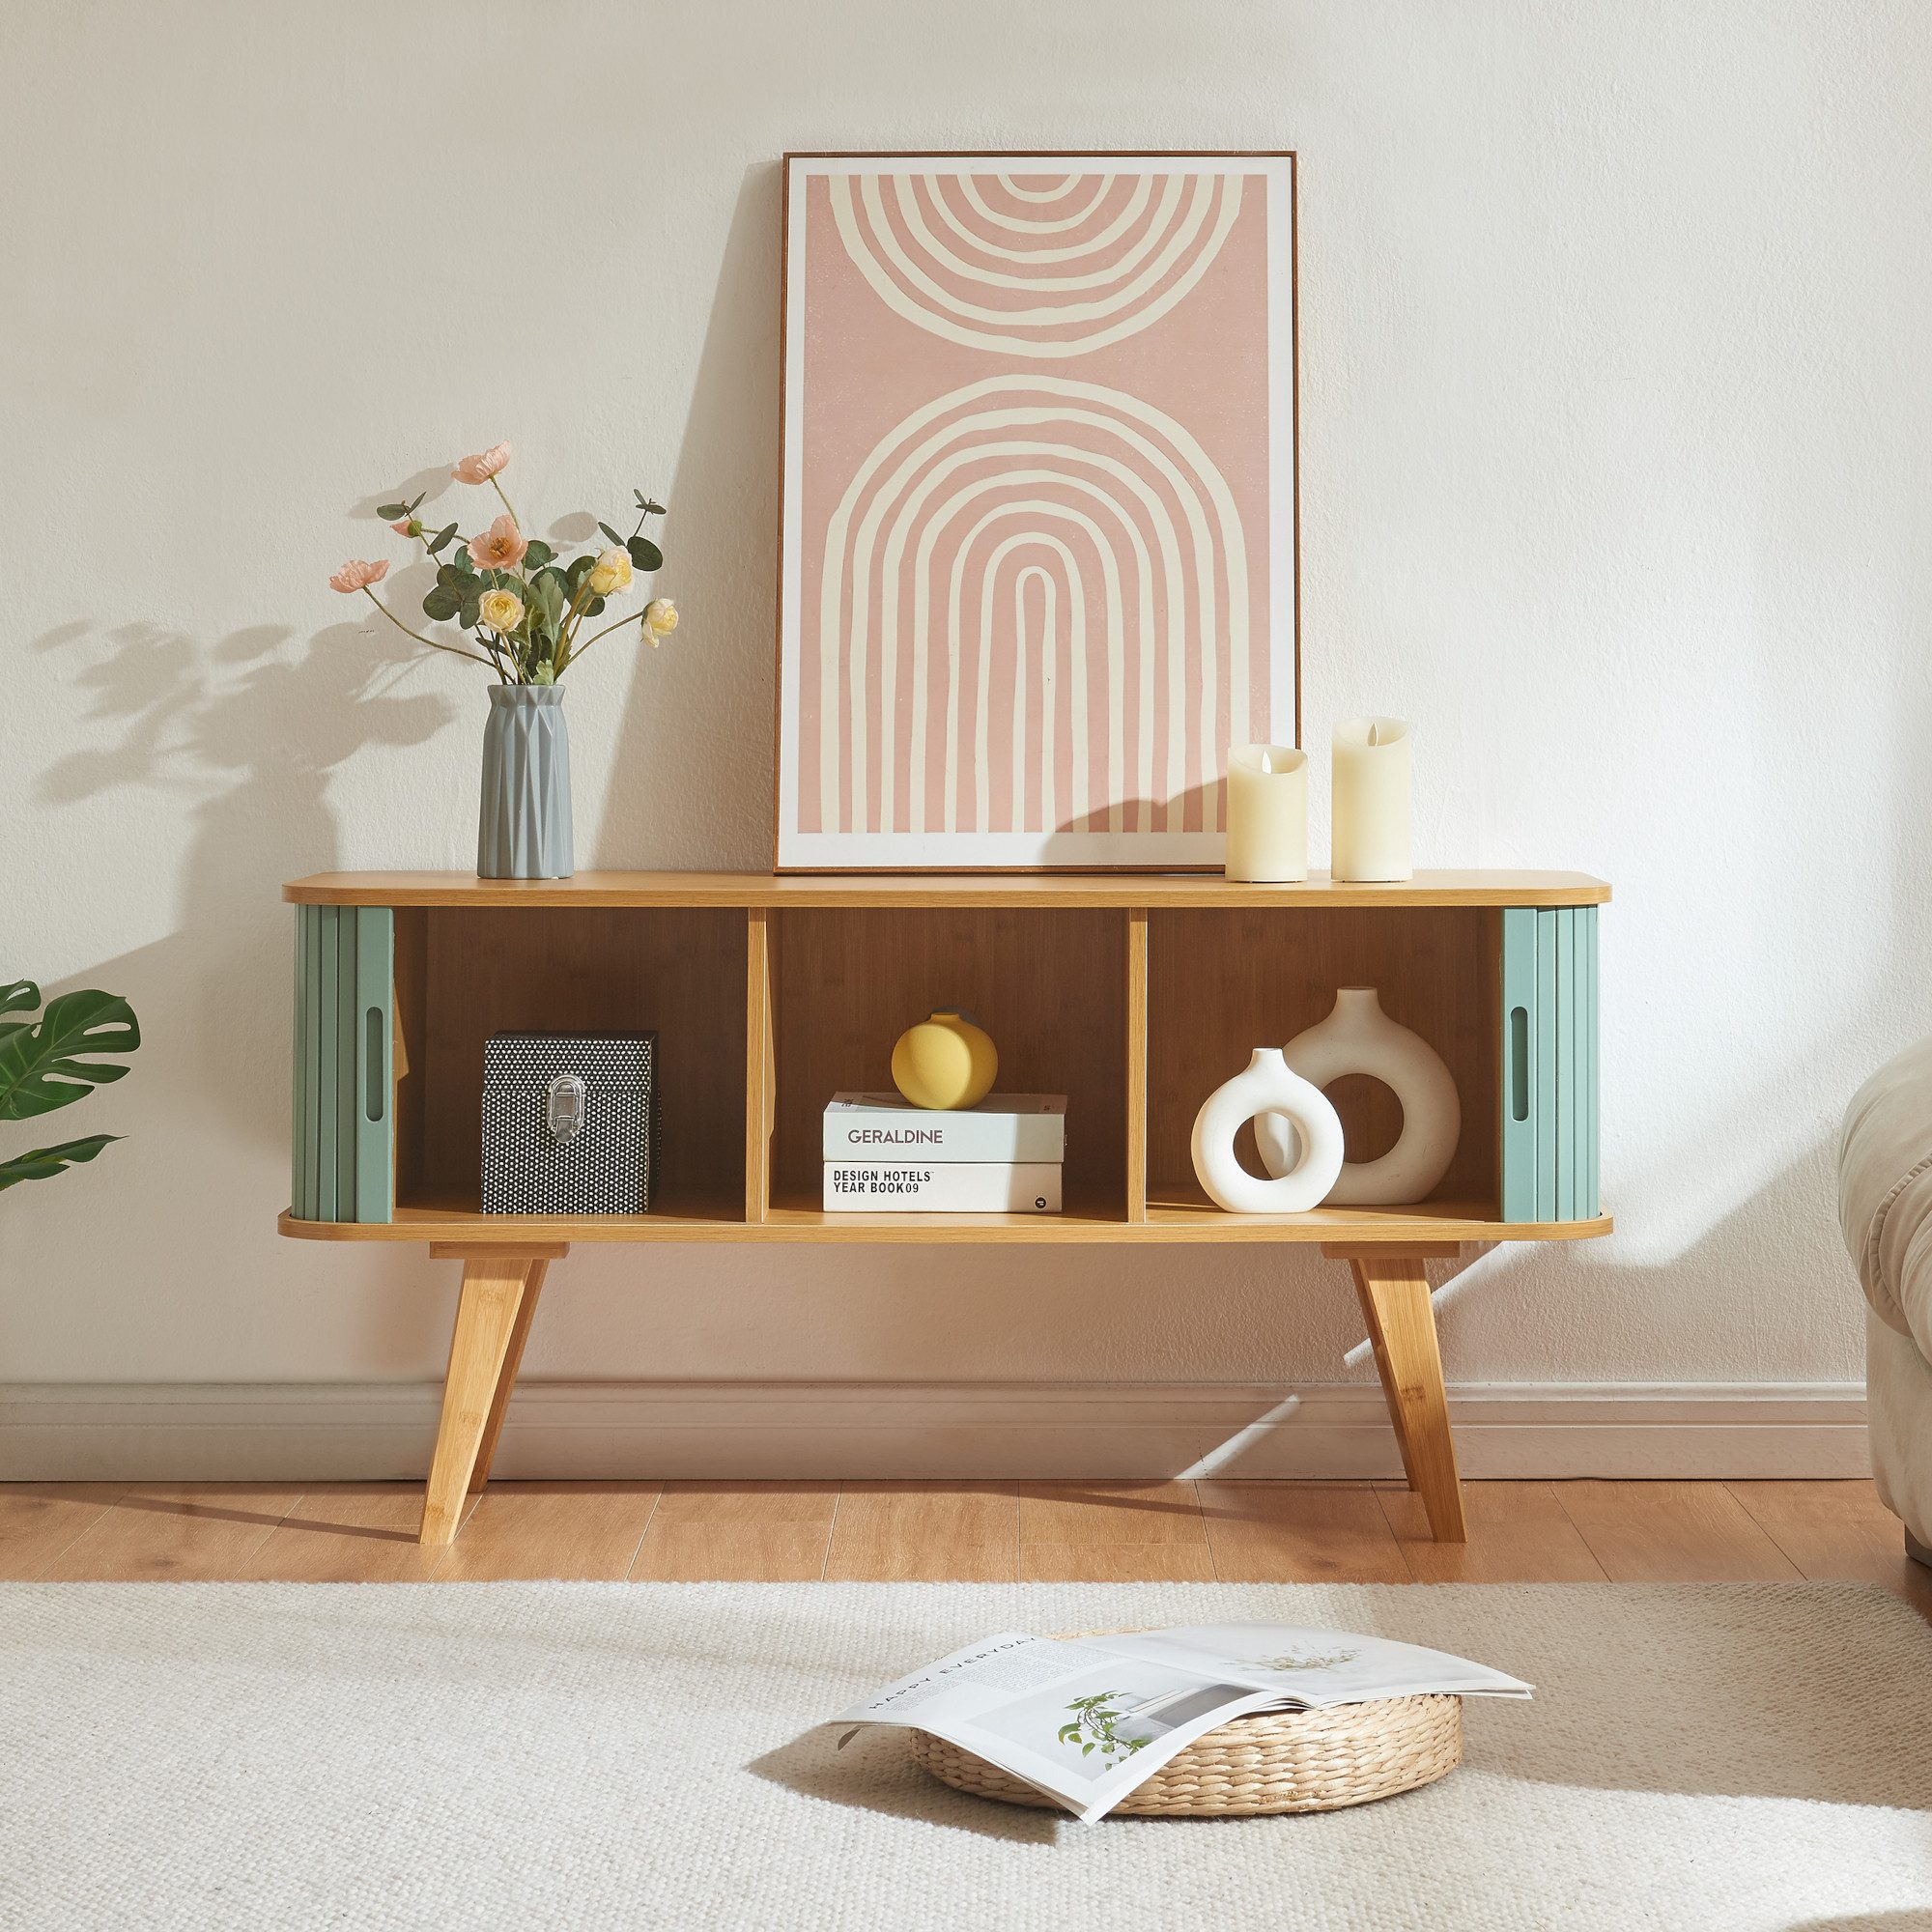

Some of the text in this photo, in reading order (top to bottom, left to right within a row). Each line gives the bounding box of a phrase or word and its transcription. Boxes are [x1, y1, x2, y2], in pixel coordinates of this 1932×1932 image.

[847, 1129, 944, 1144] GERALDINE
[834, 1170, 931, 1182] DESIGN HOTELS
[833, 1181, 866, 1193] YEAR
[868, 1637, 1036, 1709] HAPPY EVERYDAY
